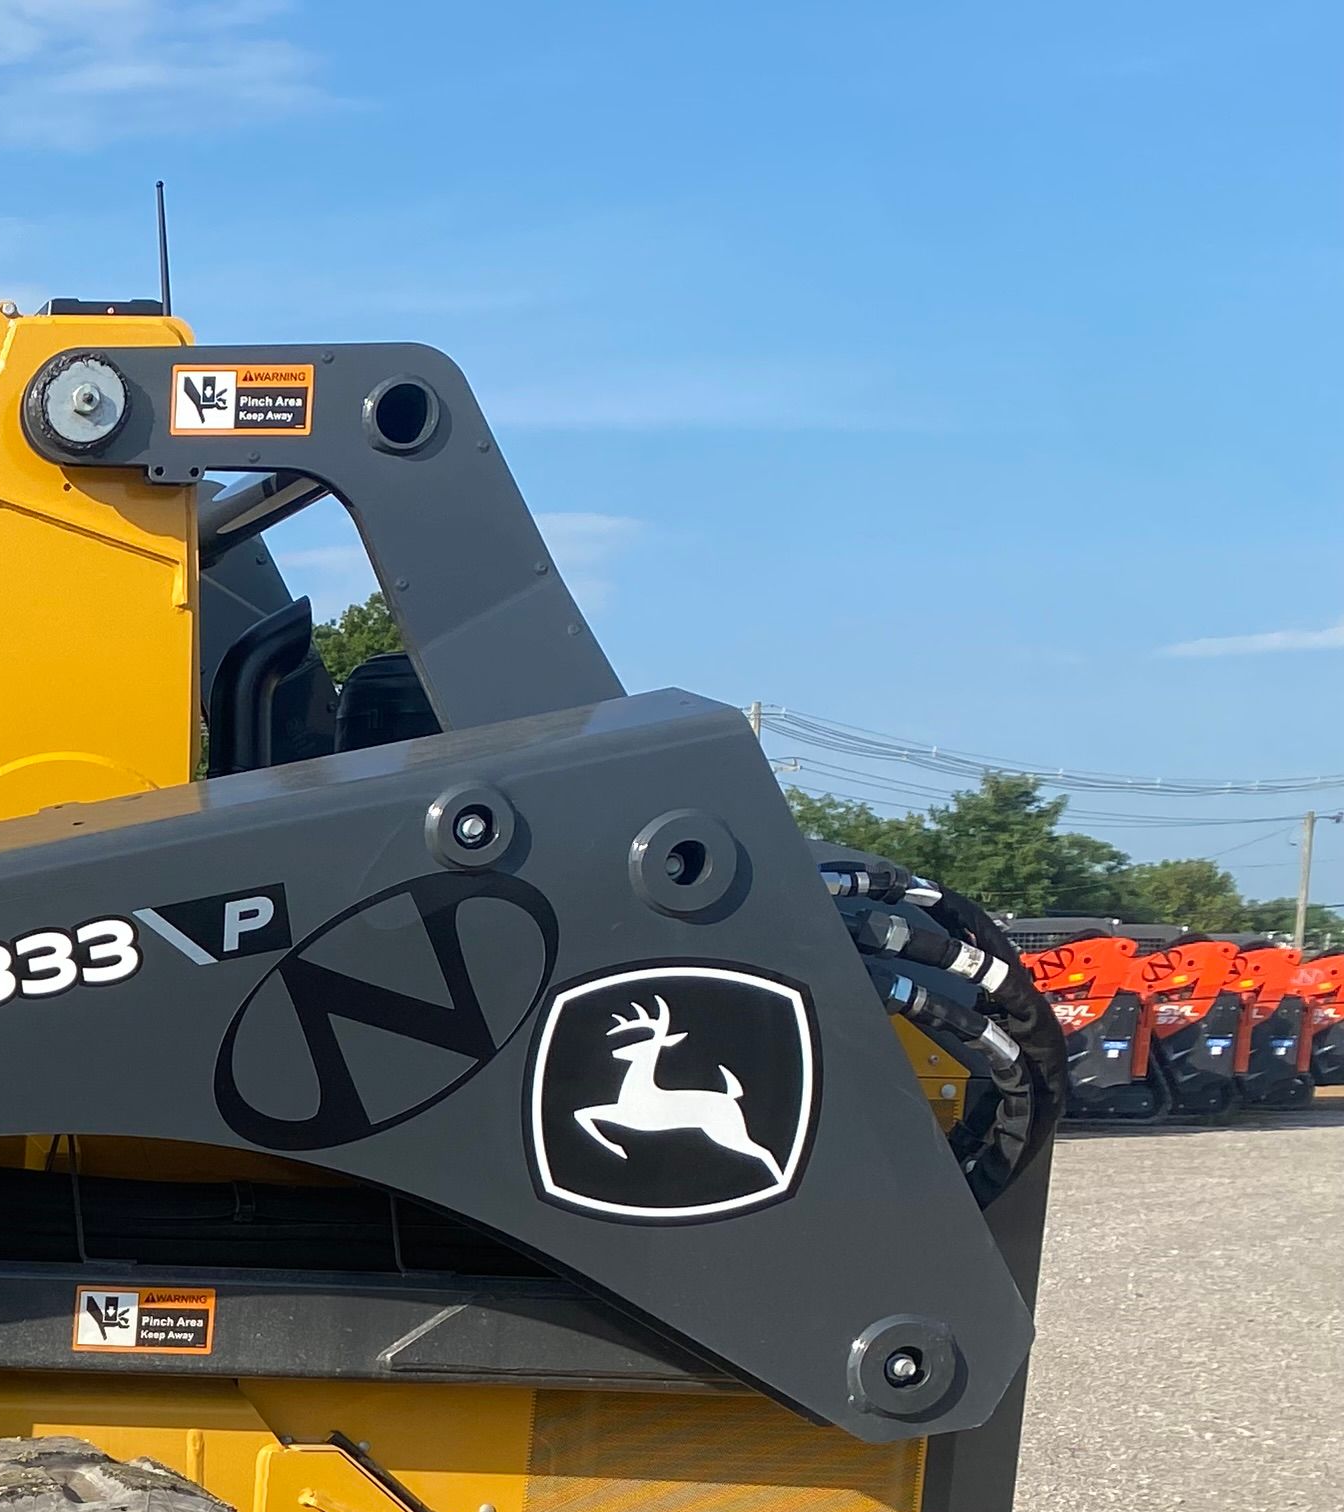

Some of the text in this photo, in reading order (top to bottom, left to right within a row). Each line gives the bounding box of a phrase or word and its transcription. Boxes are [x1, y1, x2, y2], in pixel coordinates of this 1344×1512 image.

[254, 372, 306, 382] WARNING
[239, 396, 303, 407] Pinch Area
[238, 411, 293, 422] Keep Away
[223, 895, 275, 952] P
[1053, 1005, 1097, 1017] SVL
[156, 1293, 208, 1304] WARNING
[141, 1316, 204, 1327] Pinch Area
[140, 1330, 194, 1342] Keep Away
